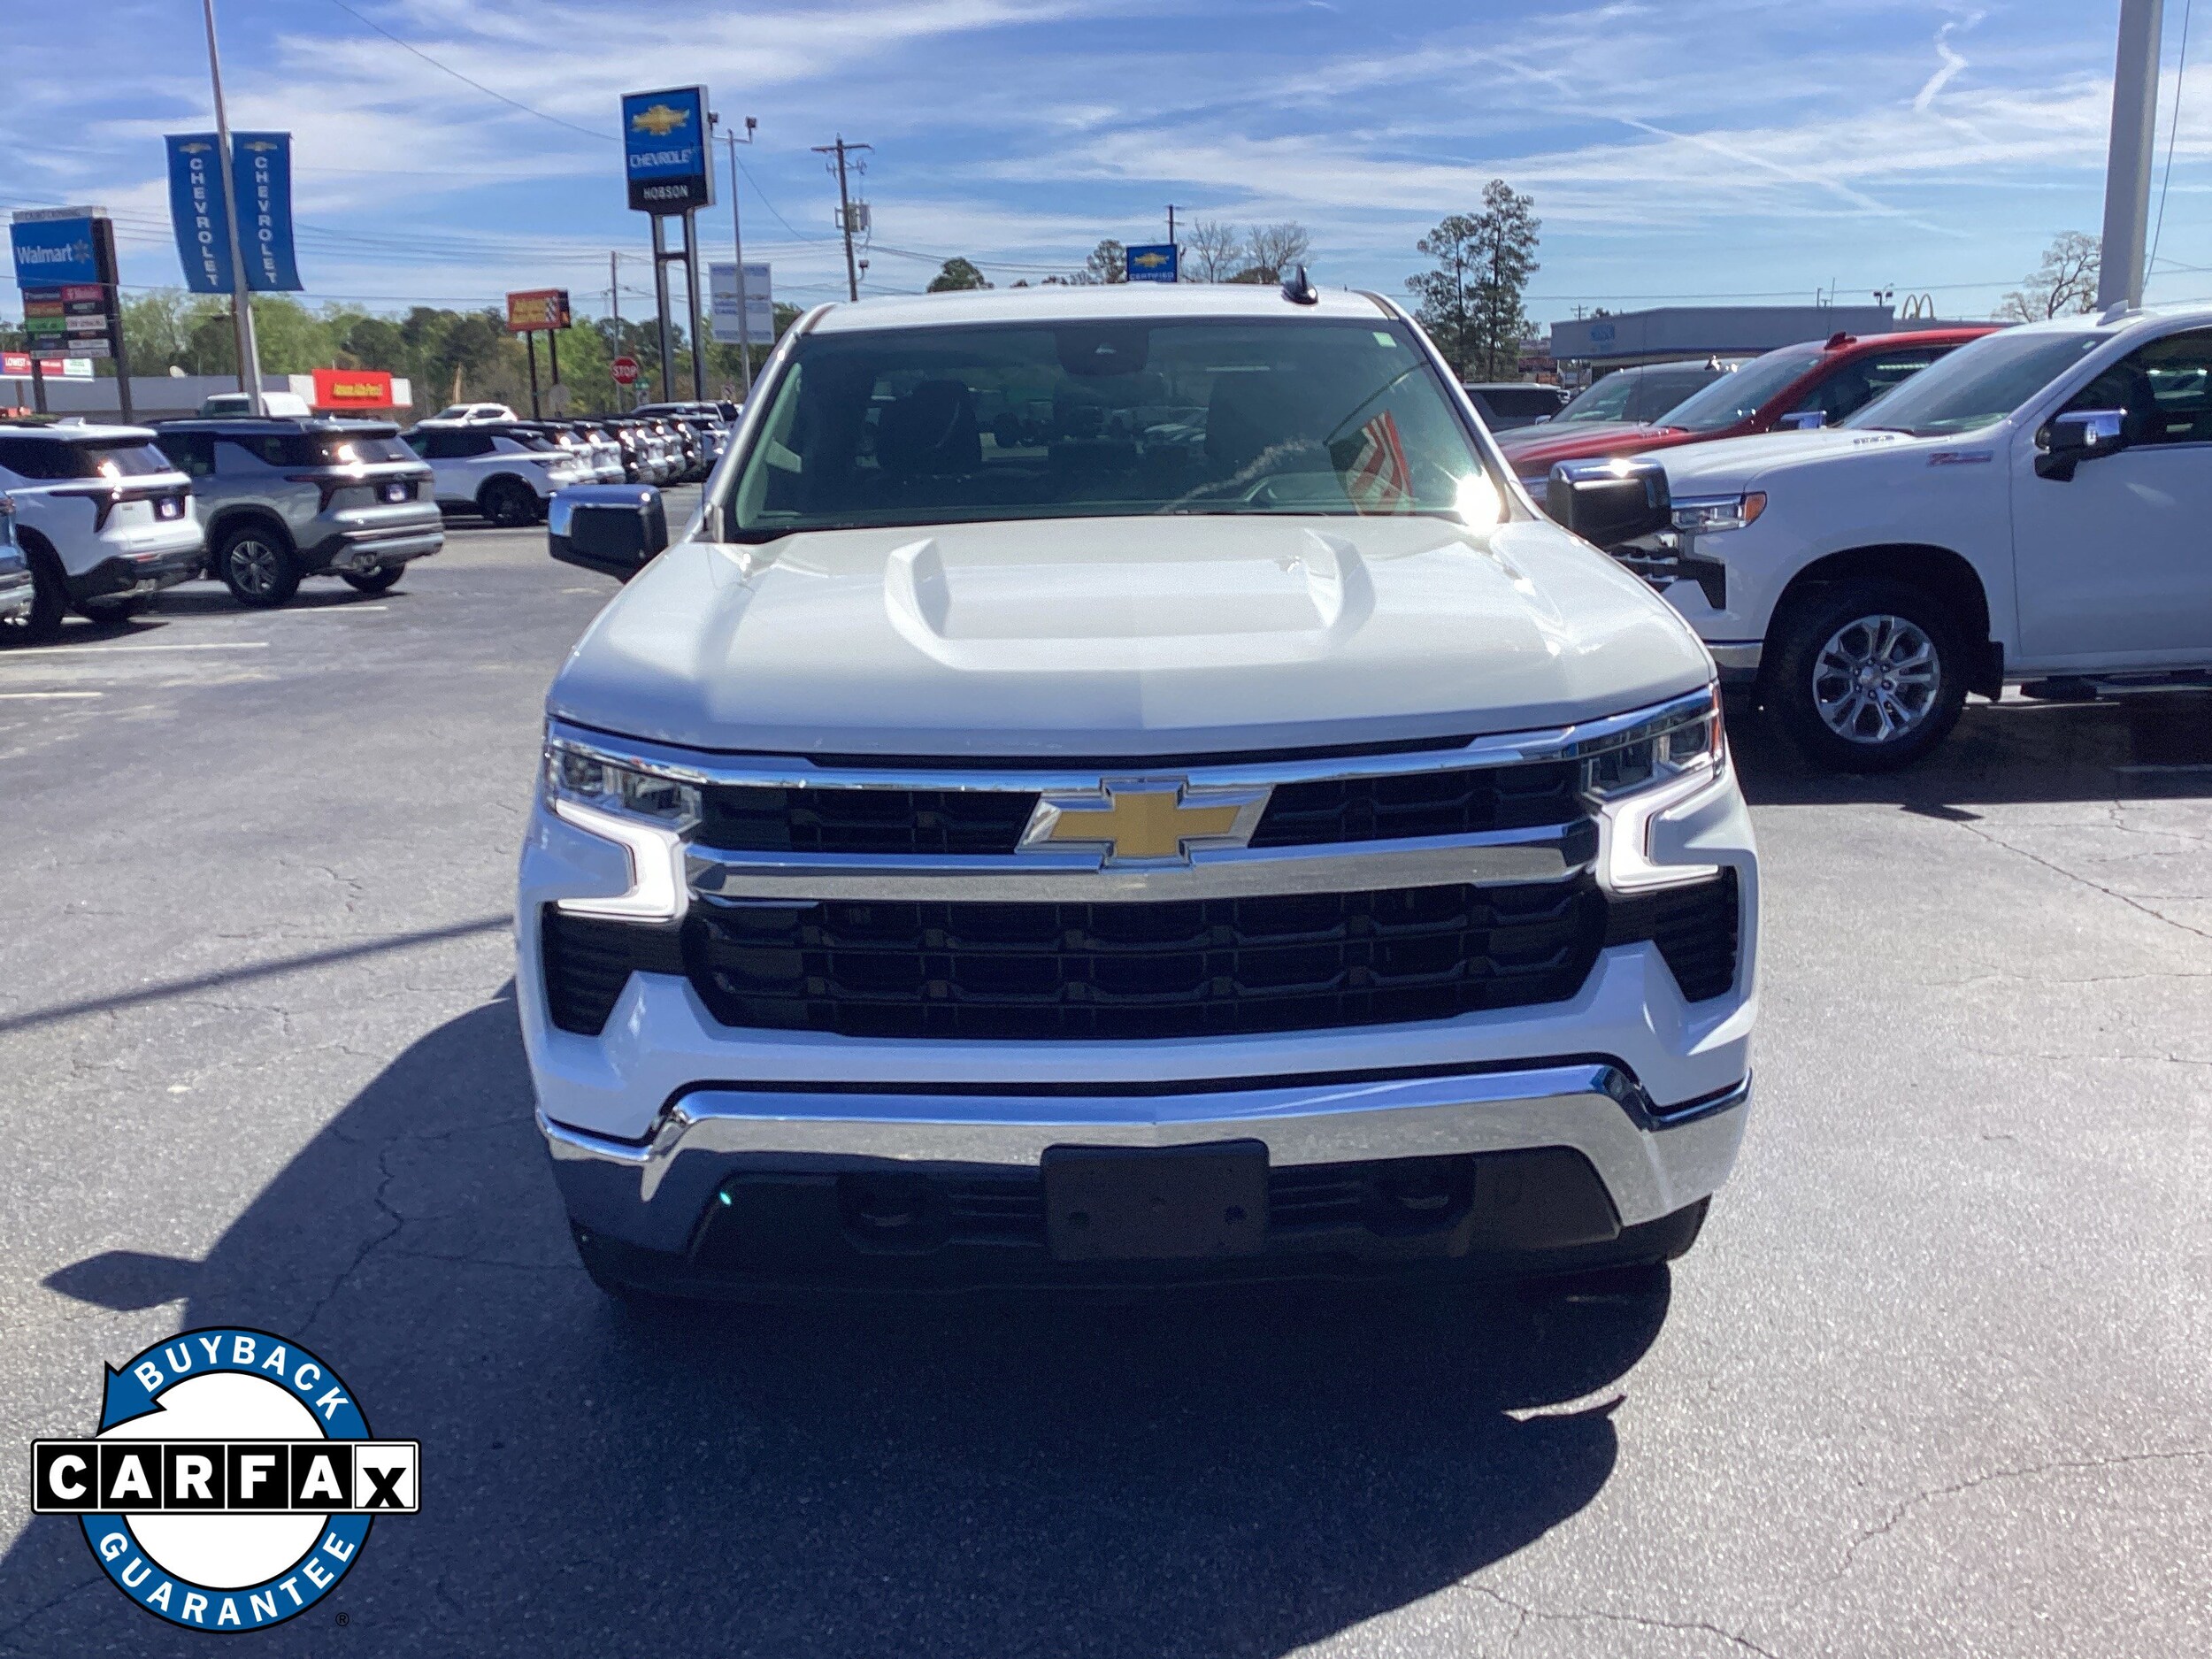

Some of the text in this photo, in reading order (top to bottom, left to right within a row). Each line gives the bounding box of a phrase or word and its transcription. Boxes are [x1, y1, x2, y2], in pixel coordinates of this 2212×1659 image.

[629, 149, 694, 168] CHEVROLE
[643, 185, 688, 200] HOBSON
[189, 157, 219, 286] CHEVROLET
[254, 156, 278, 284] CHEVROLET
[18, 243, 73, 265] Walmart
[612, 365, 637, 377] STOP
